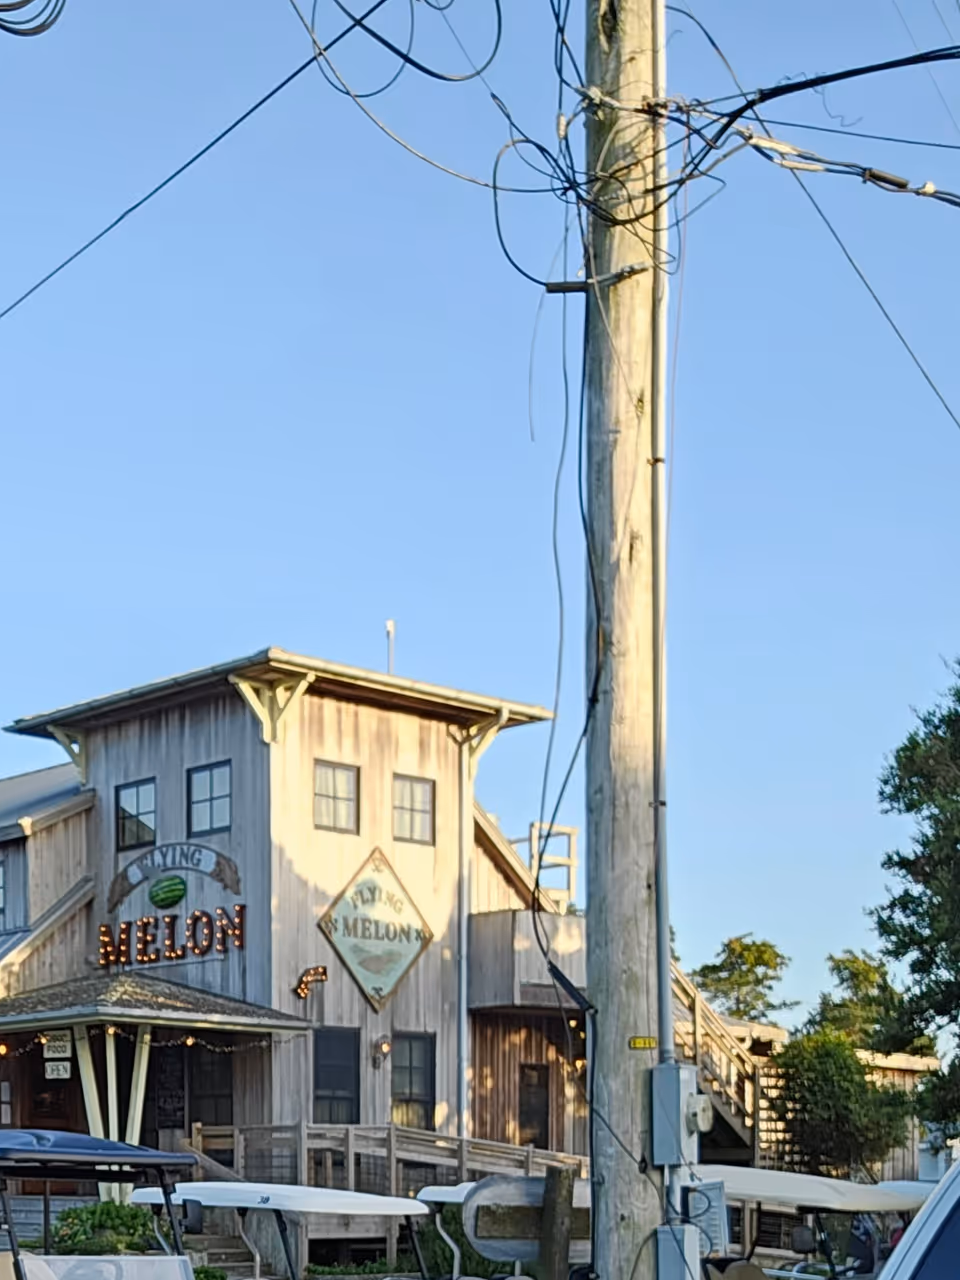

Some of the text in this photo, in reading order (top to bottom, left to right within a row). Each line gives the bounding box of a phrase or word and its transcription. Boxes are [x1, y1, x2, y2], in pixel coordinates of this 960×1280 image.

[351, 885, 403, 915] FLYING
[99, 904, 246, 966] MELON
[342, 917, 411, 944] MELON
